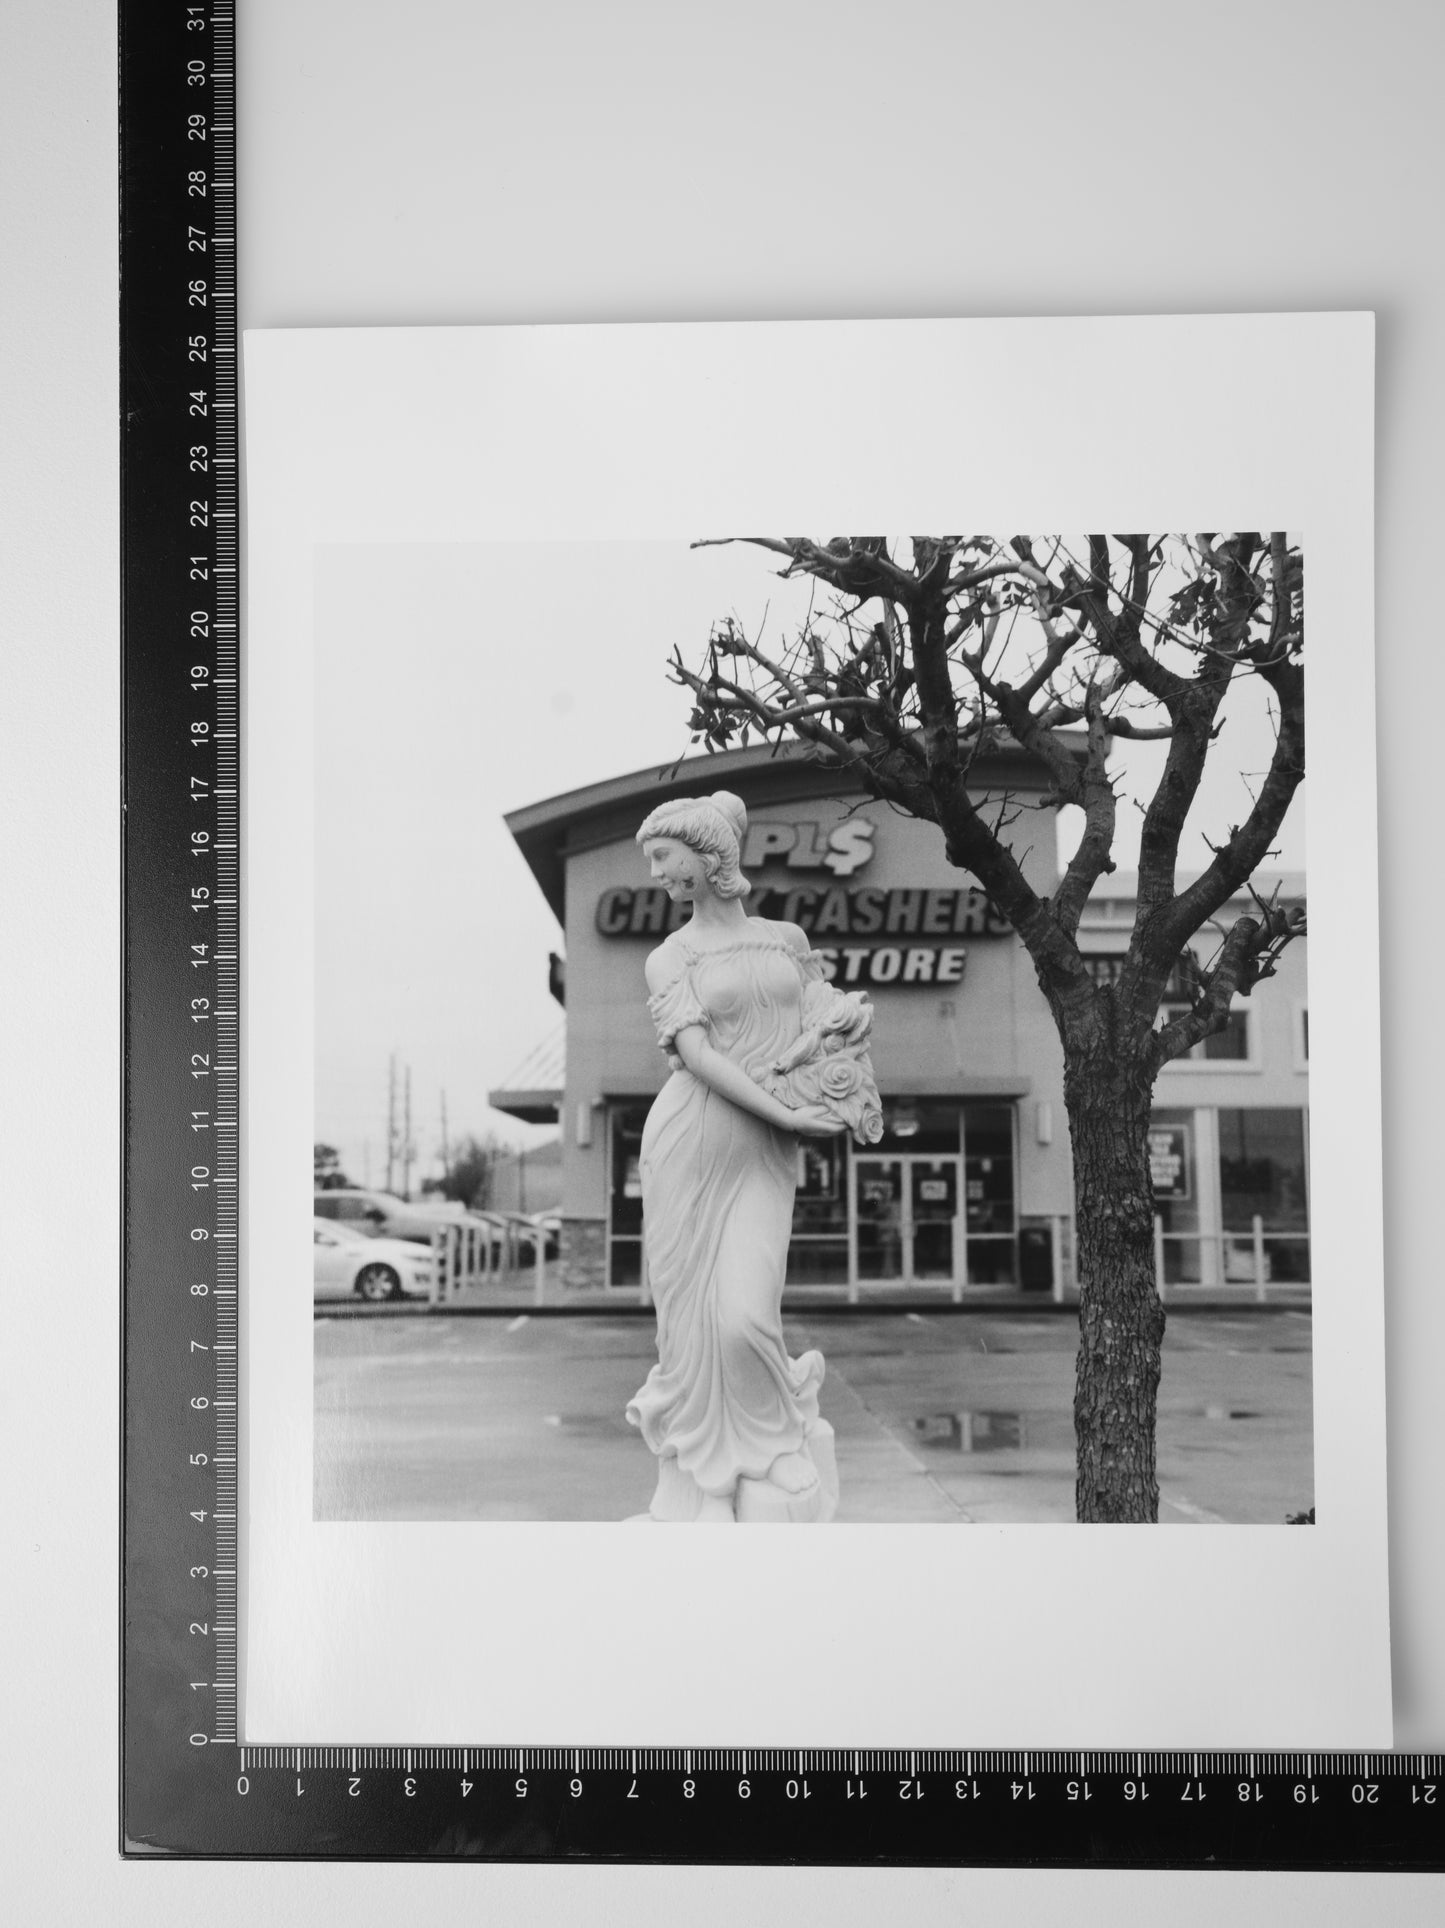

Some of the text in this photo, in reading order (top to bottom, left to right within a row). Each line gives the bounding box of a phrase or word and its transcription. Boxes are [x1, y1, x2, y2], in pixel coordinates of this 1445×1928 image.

[186, 7, 210, 1746] 0 1 2 3 4 5 6 7 8 9 10 11 12 13 14 15 16 17 18 19 20 21 22 23 24 25 26 27 28 29 30 31
[597, 886, 770, 934] CHEK
[822, 947, 966, 982] STORE
[236, 1776, 1437, 1805] 21 20 19 18 17 16 15 14 13 12 11 10 9 8 7 6 5 4 3 2 1 0
